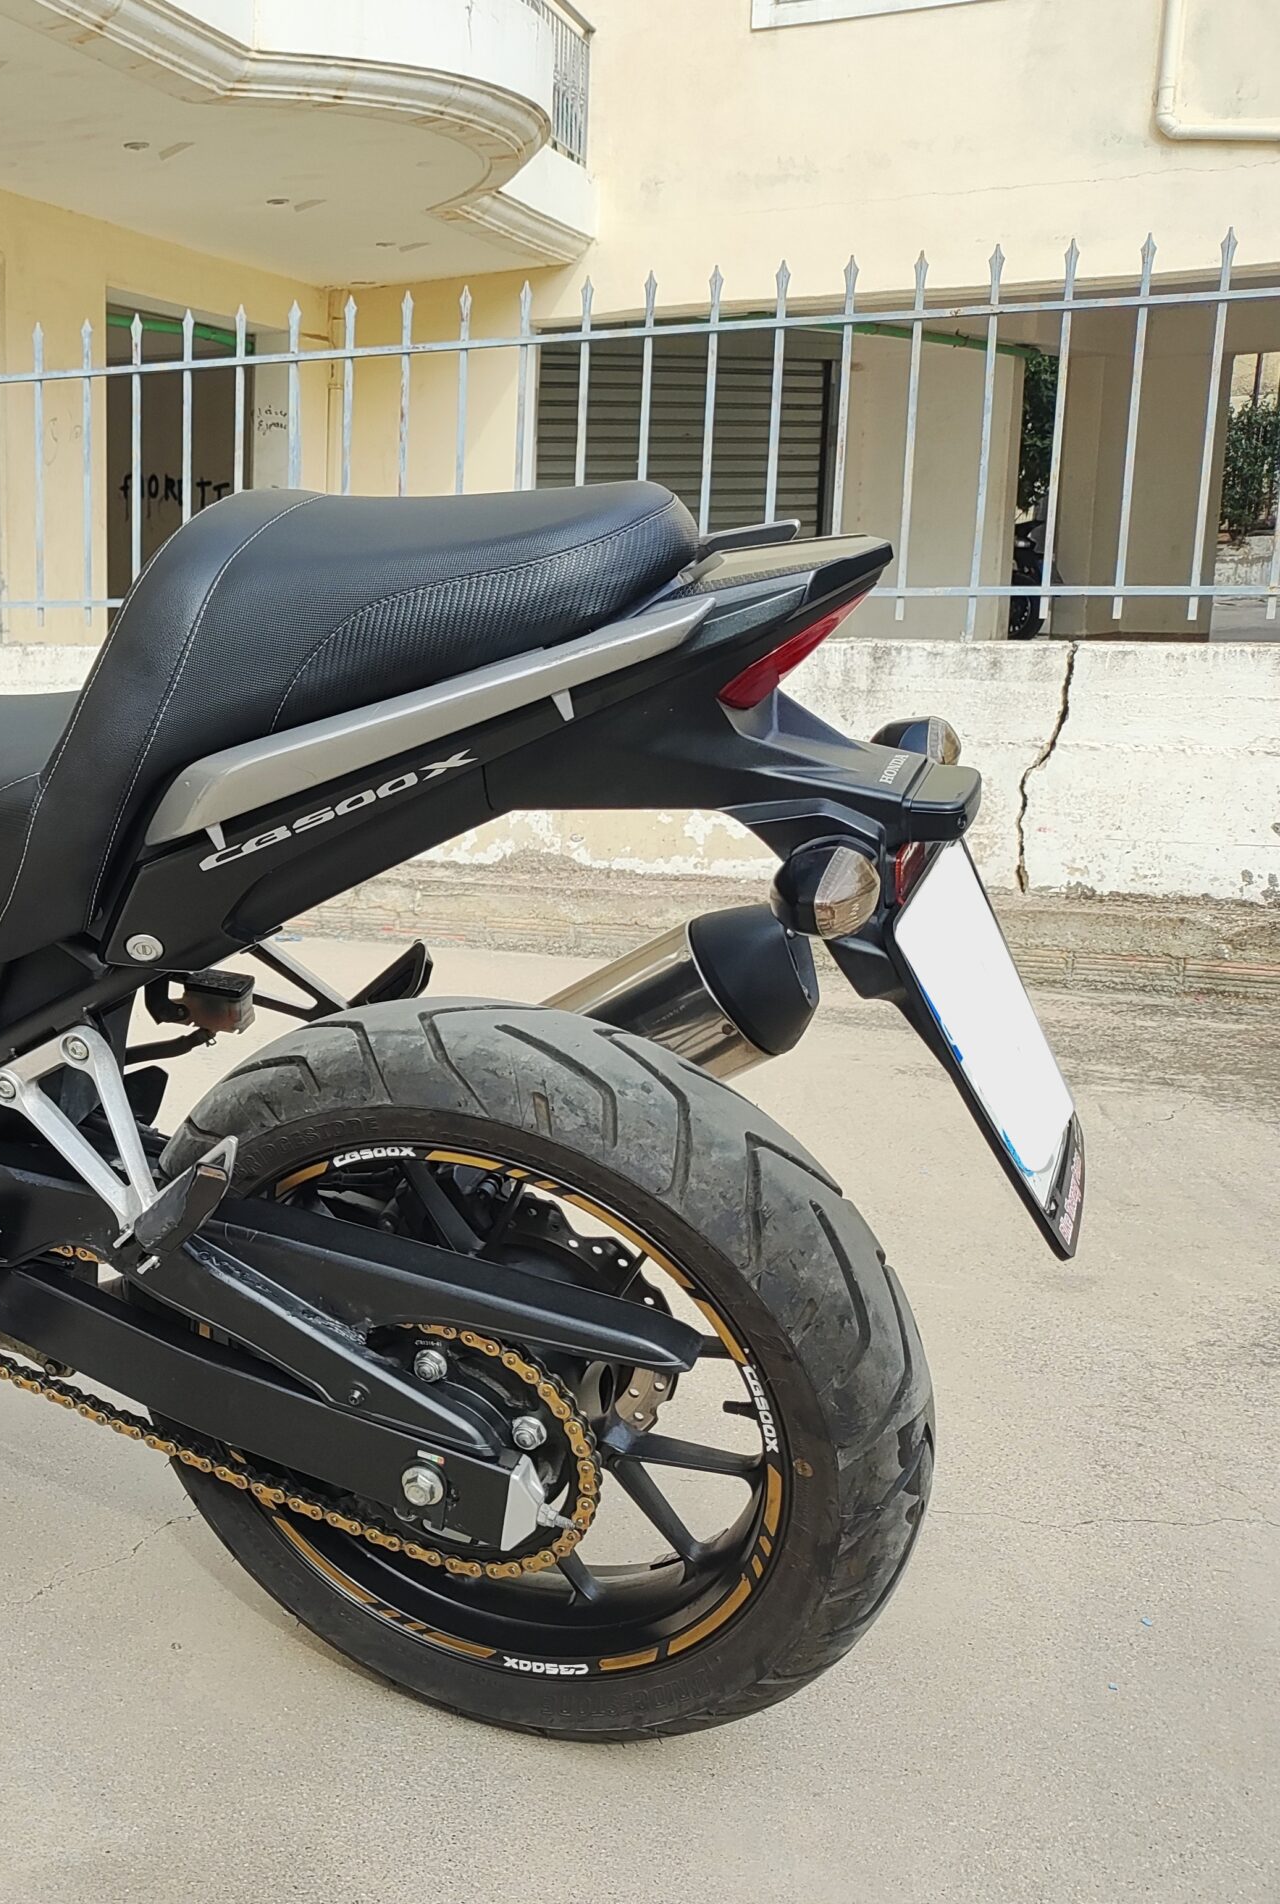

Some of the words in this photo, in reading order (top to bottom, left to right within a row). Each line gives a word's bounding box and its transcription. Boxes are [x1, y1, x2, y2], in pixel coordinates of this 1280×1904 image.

[879, 754, 909, 785] HONDA
[198, 748, 478, 872] CB500X
[332, 1146, 417, 1168] CB500X
[742, 1365, 780, 1454] CB500X
[503, 1655, 590, 1675] CB500X
